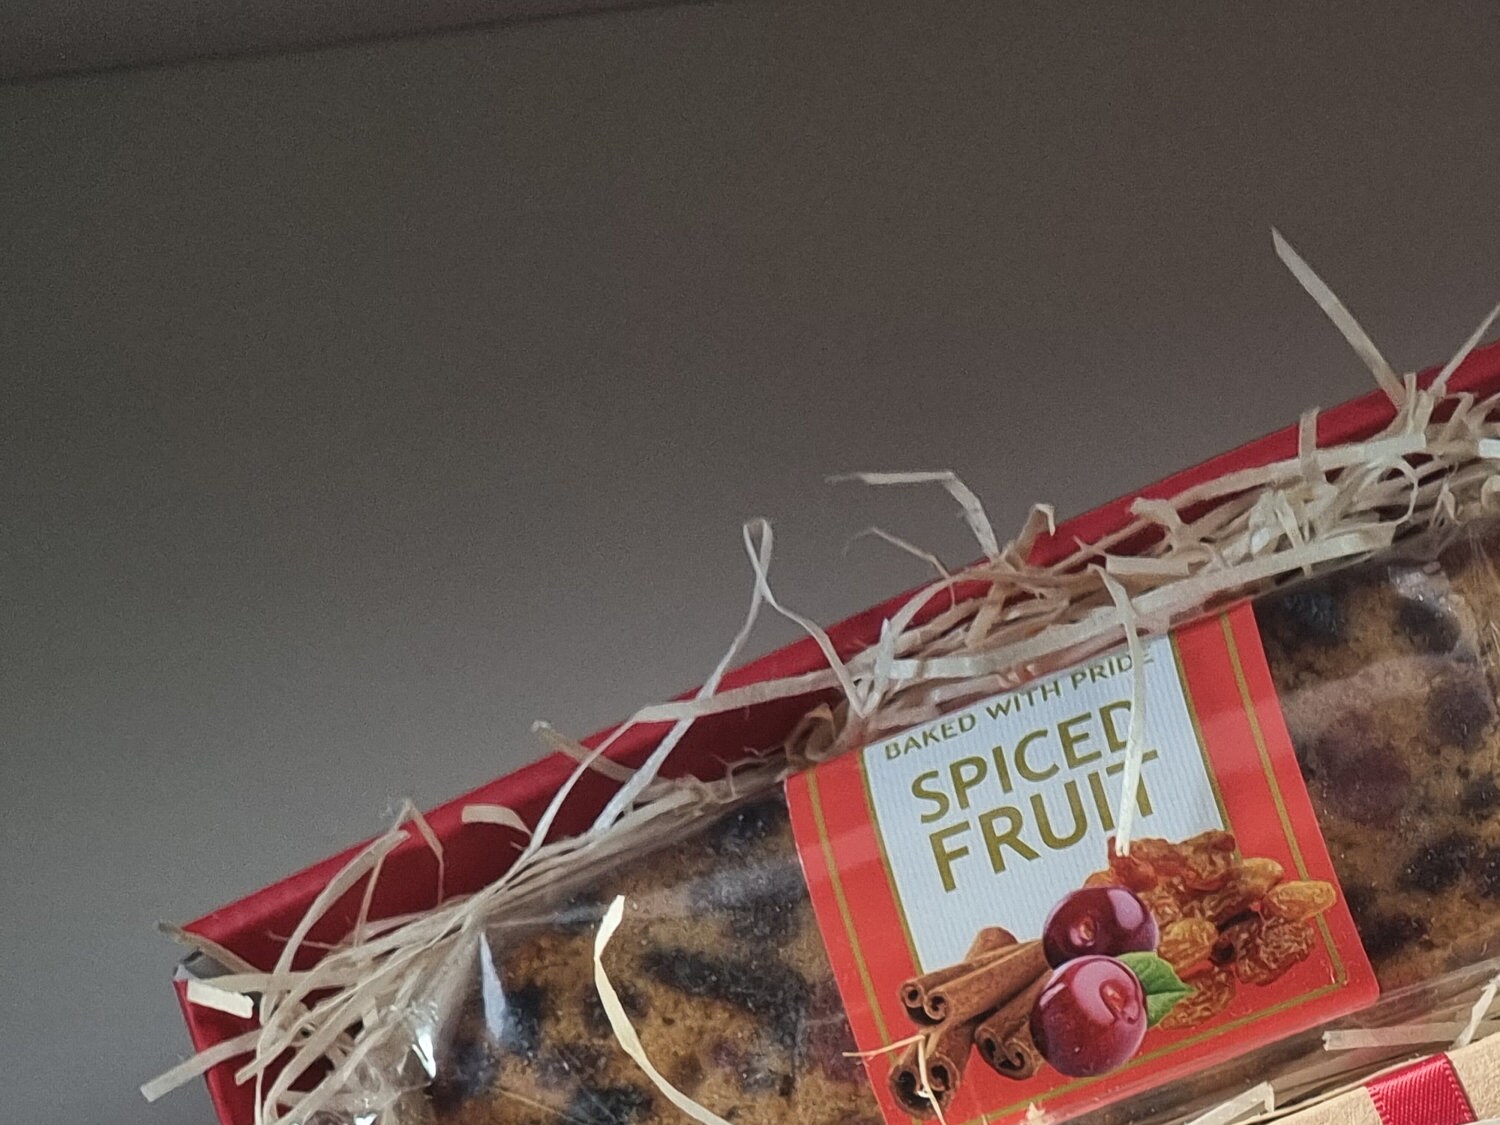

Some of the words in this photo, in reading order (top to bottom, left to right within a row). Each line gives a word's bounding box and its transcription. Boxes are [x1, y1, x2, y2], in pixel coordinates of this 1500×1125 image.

[884, 713, 977, 761] BAKED
[985, 680, 1062, 721] WITH
[911, 699, 1138, 825] SPICED
[928, 749, 1160, 893] FRUIT
